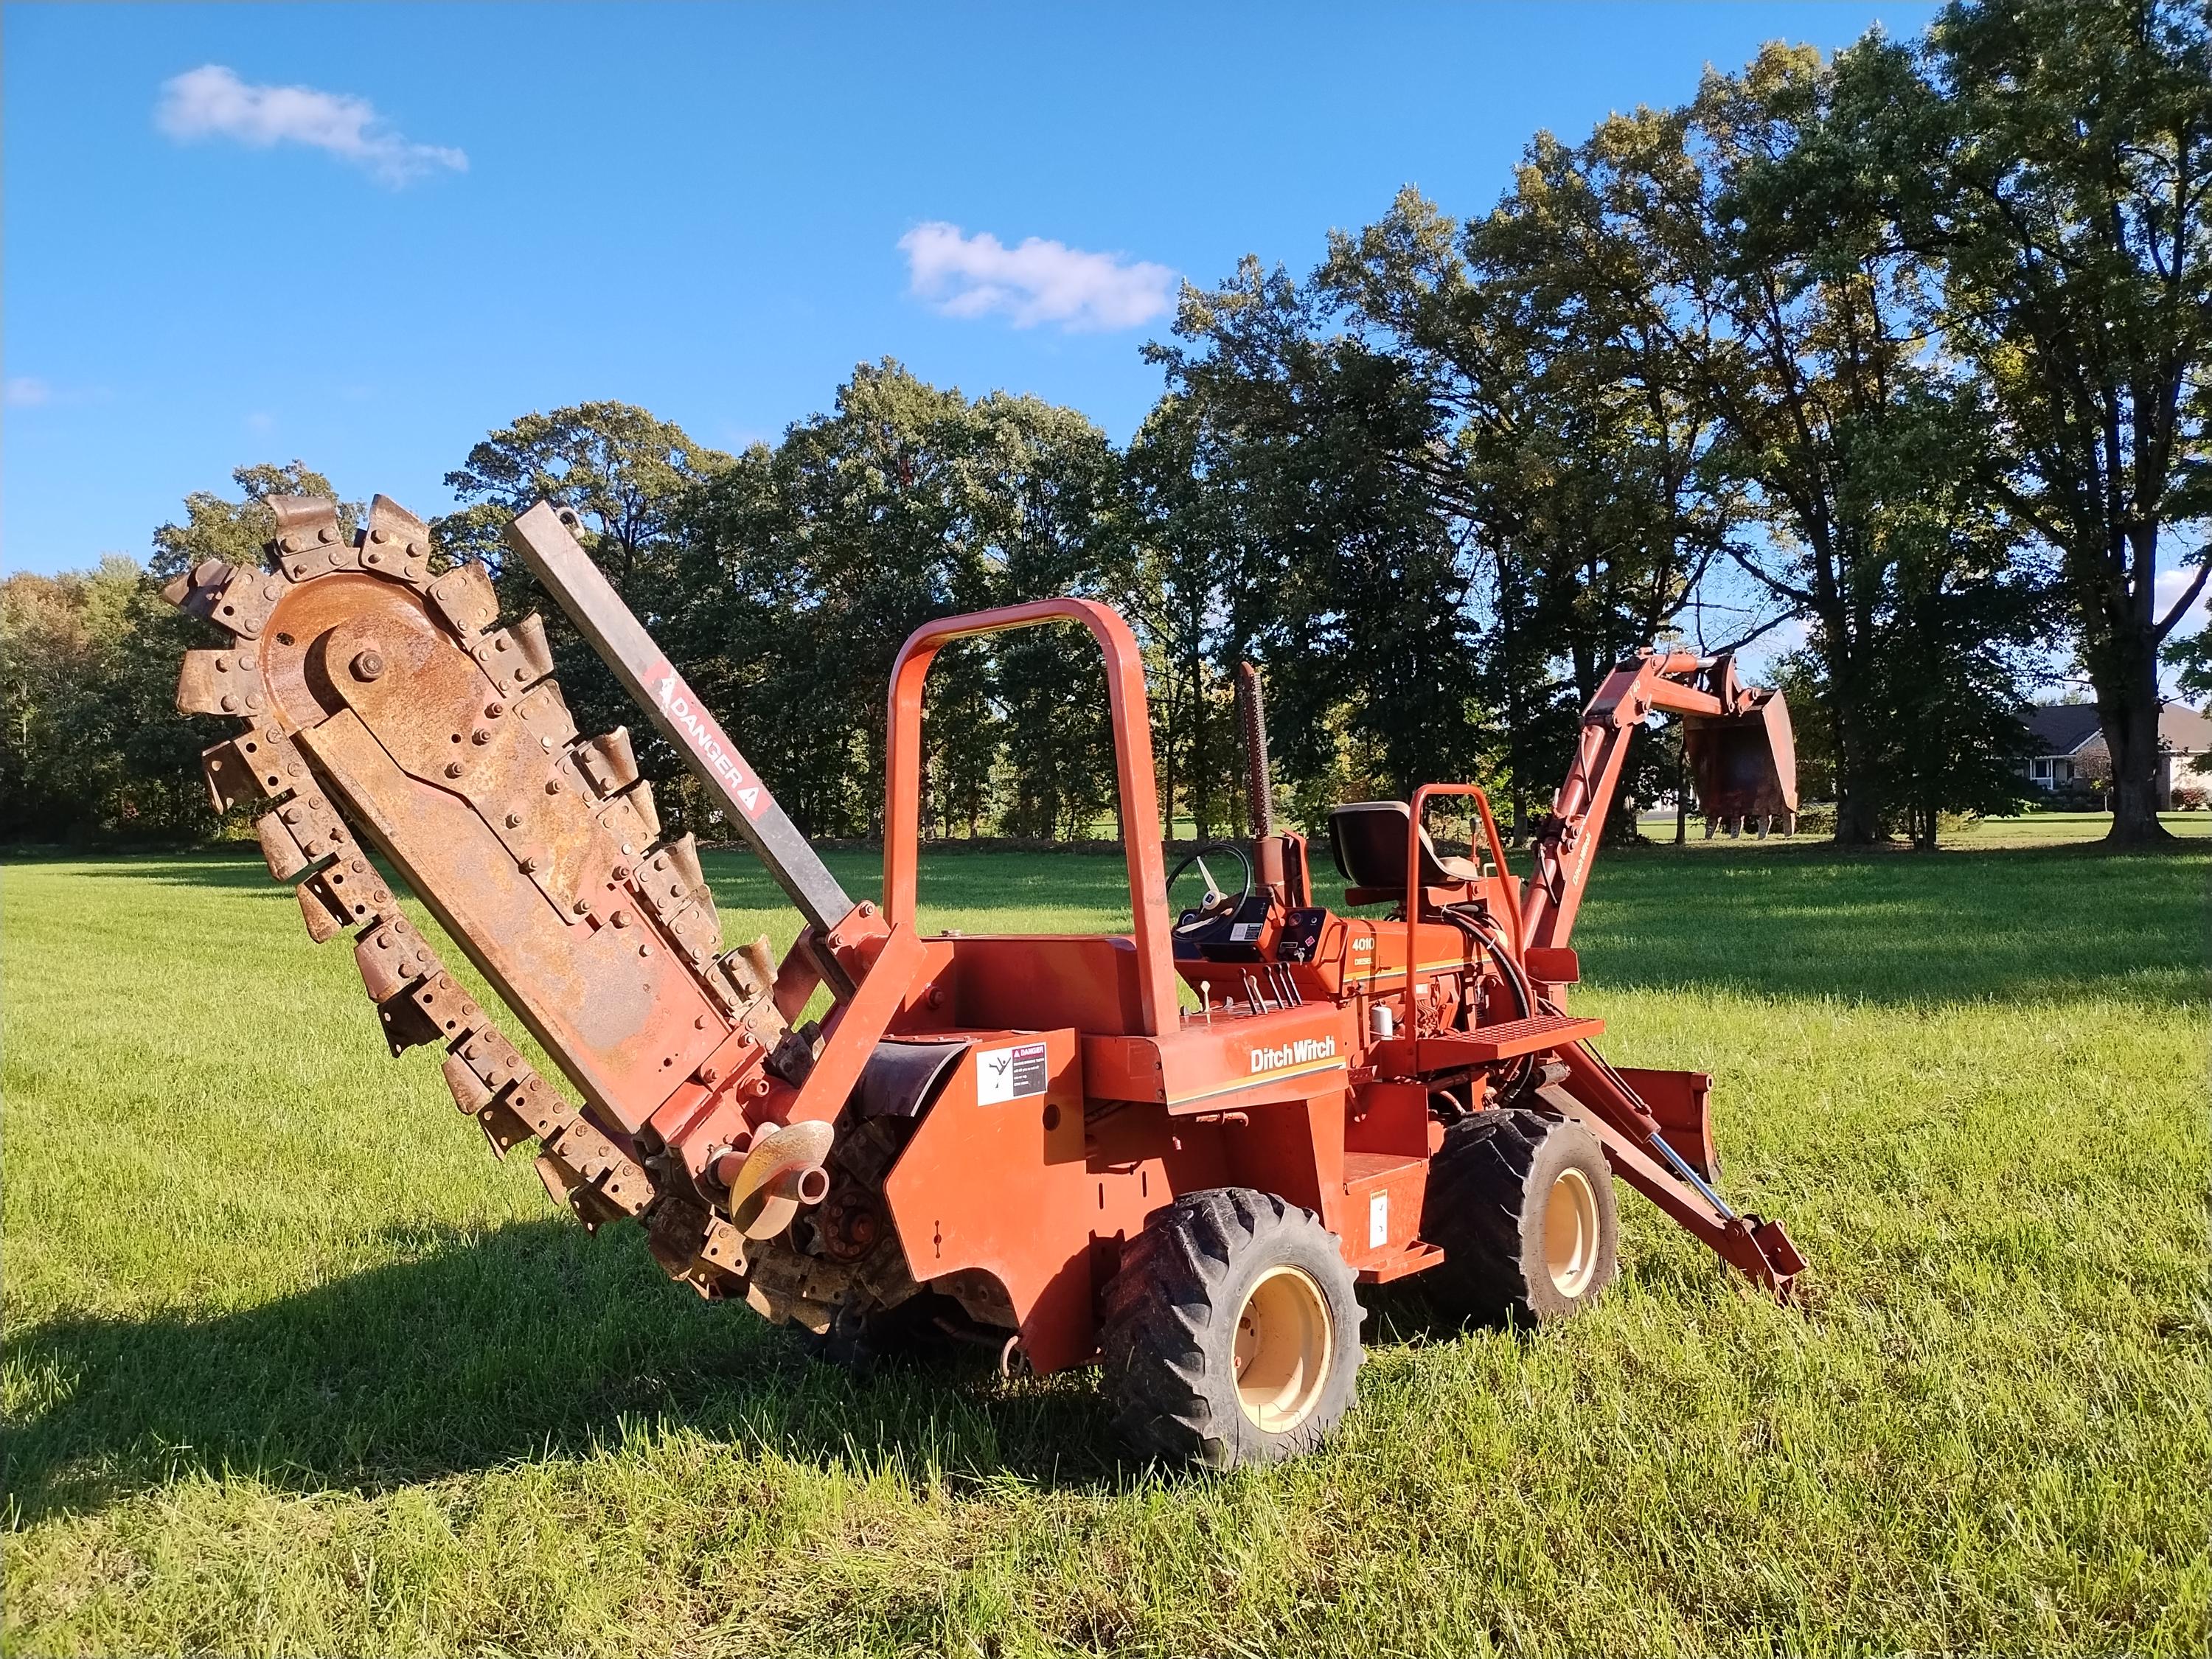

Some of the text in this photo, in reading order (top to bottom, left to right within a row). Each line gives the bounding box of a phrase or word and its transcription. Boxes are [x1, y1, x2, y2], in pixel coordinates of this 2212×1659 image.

[669, 697, 743, 789] DANGER
[1572, 858, 1584, 886] Ditch
[1352, 937, 1375, 951] 4010
[1020, 1046, 1044, 1057] DANGER
[1251, 1035, 1335, 1073] Ditch Witch
